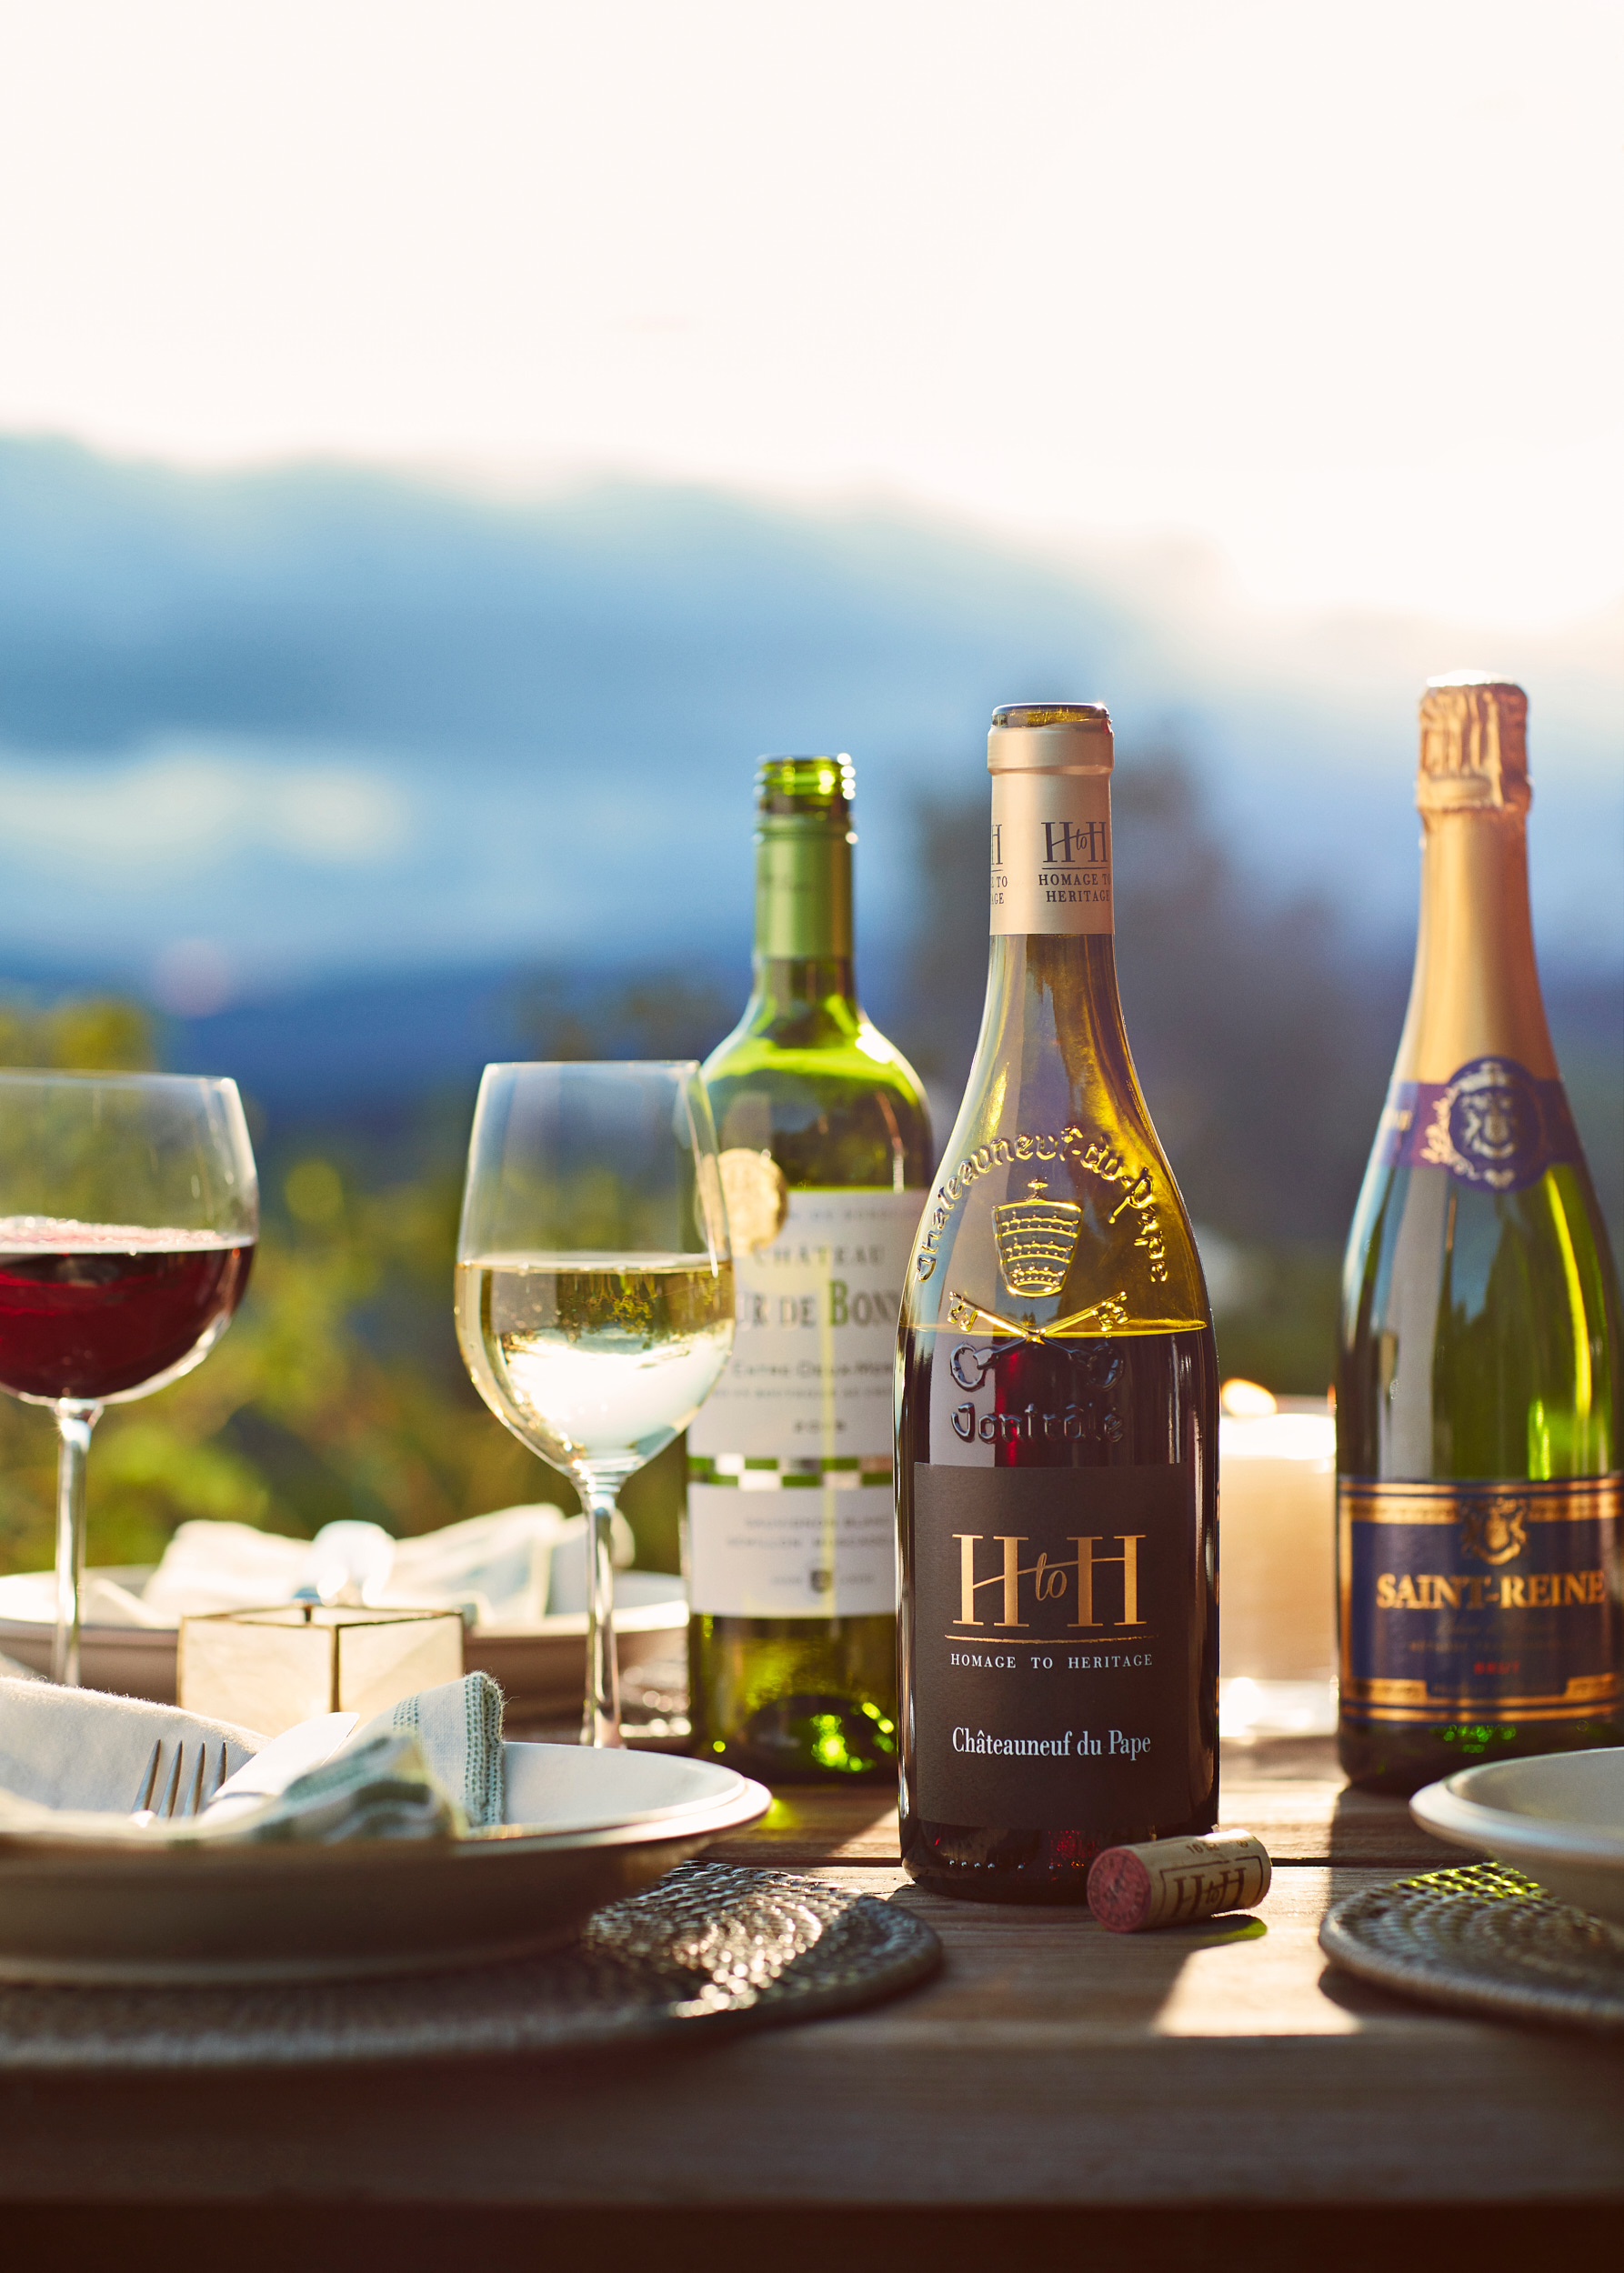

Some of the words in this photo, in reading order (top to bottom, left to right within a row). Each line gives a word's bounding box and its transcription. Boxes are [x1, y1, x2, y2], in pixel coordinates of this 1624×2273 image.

[1041, 822, 1076, 863] H
[1085, 822, 1108, 863] H
[997, 876, 1008, 888] TO
[1038, 874, 1098, 886] HOMAGE
[1046, 889, 1111, 903] HERITAGE
[952, 1534, 1030, 1627] H
[1034, 1552, 1068, 1601] to
[1066, 1534, 1148, 1627] H
[1375, 1569, 1607, 1610] SAINT-REINE
[950, 1653, 1017, 1669] HOMAGE
[1031, 1657, 1054, 1670] TO
[1068, 1653, 1153, 1670] HERITAGE
[952, 1726, 1073, 1757] Châteauneuf
[1077, 1730, 1103, 1757] du
[1108, 1729, 1151, 1762] Pape
